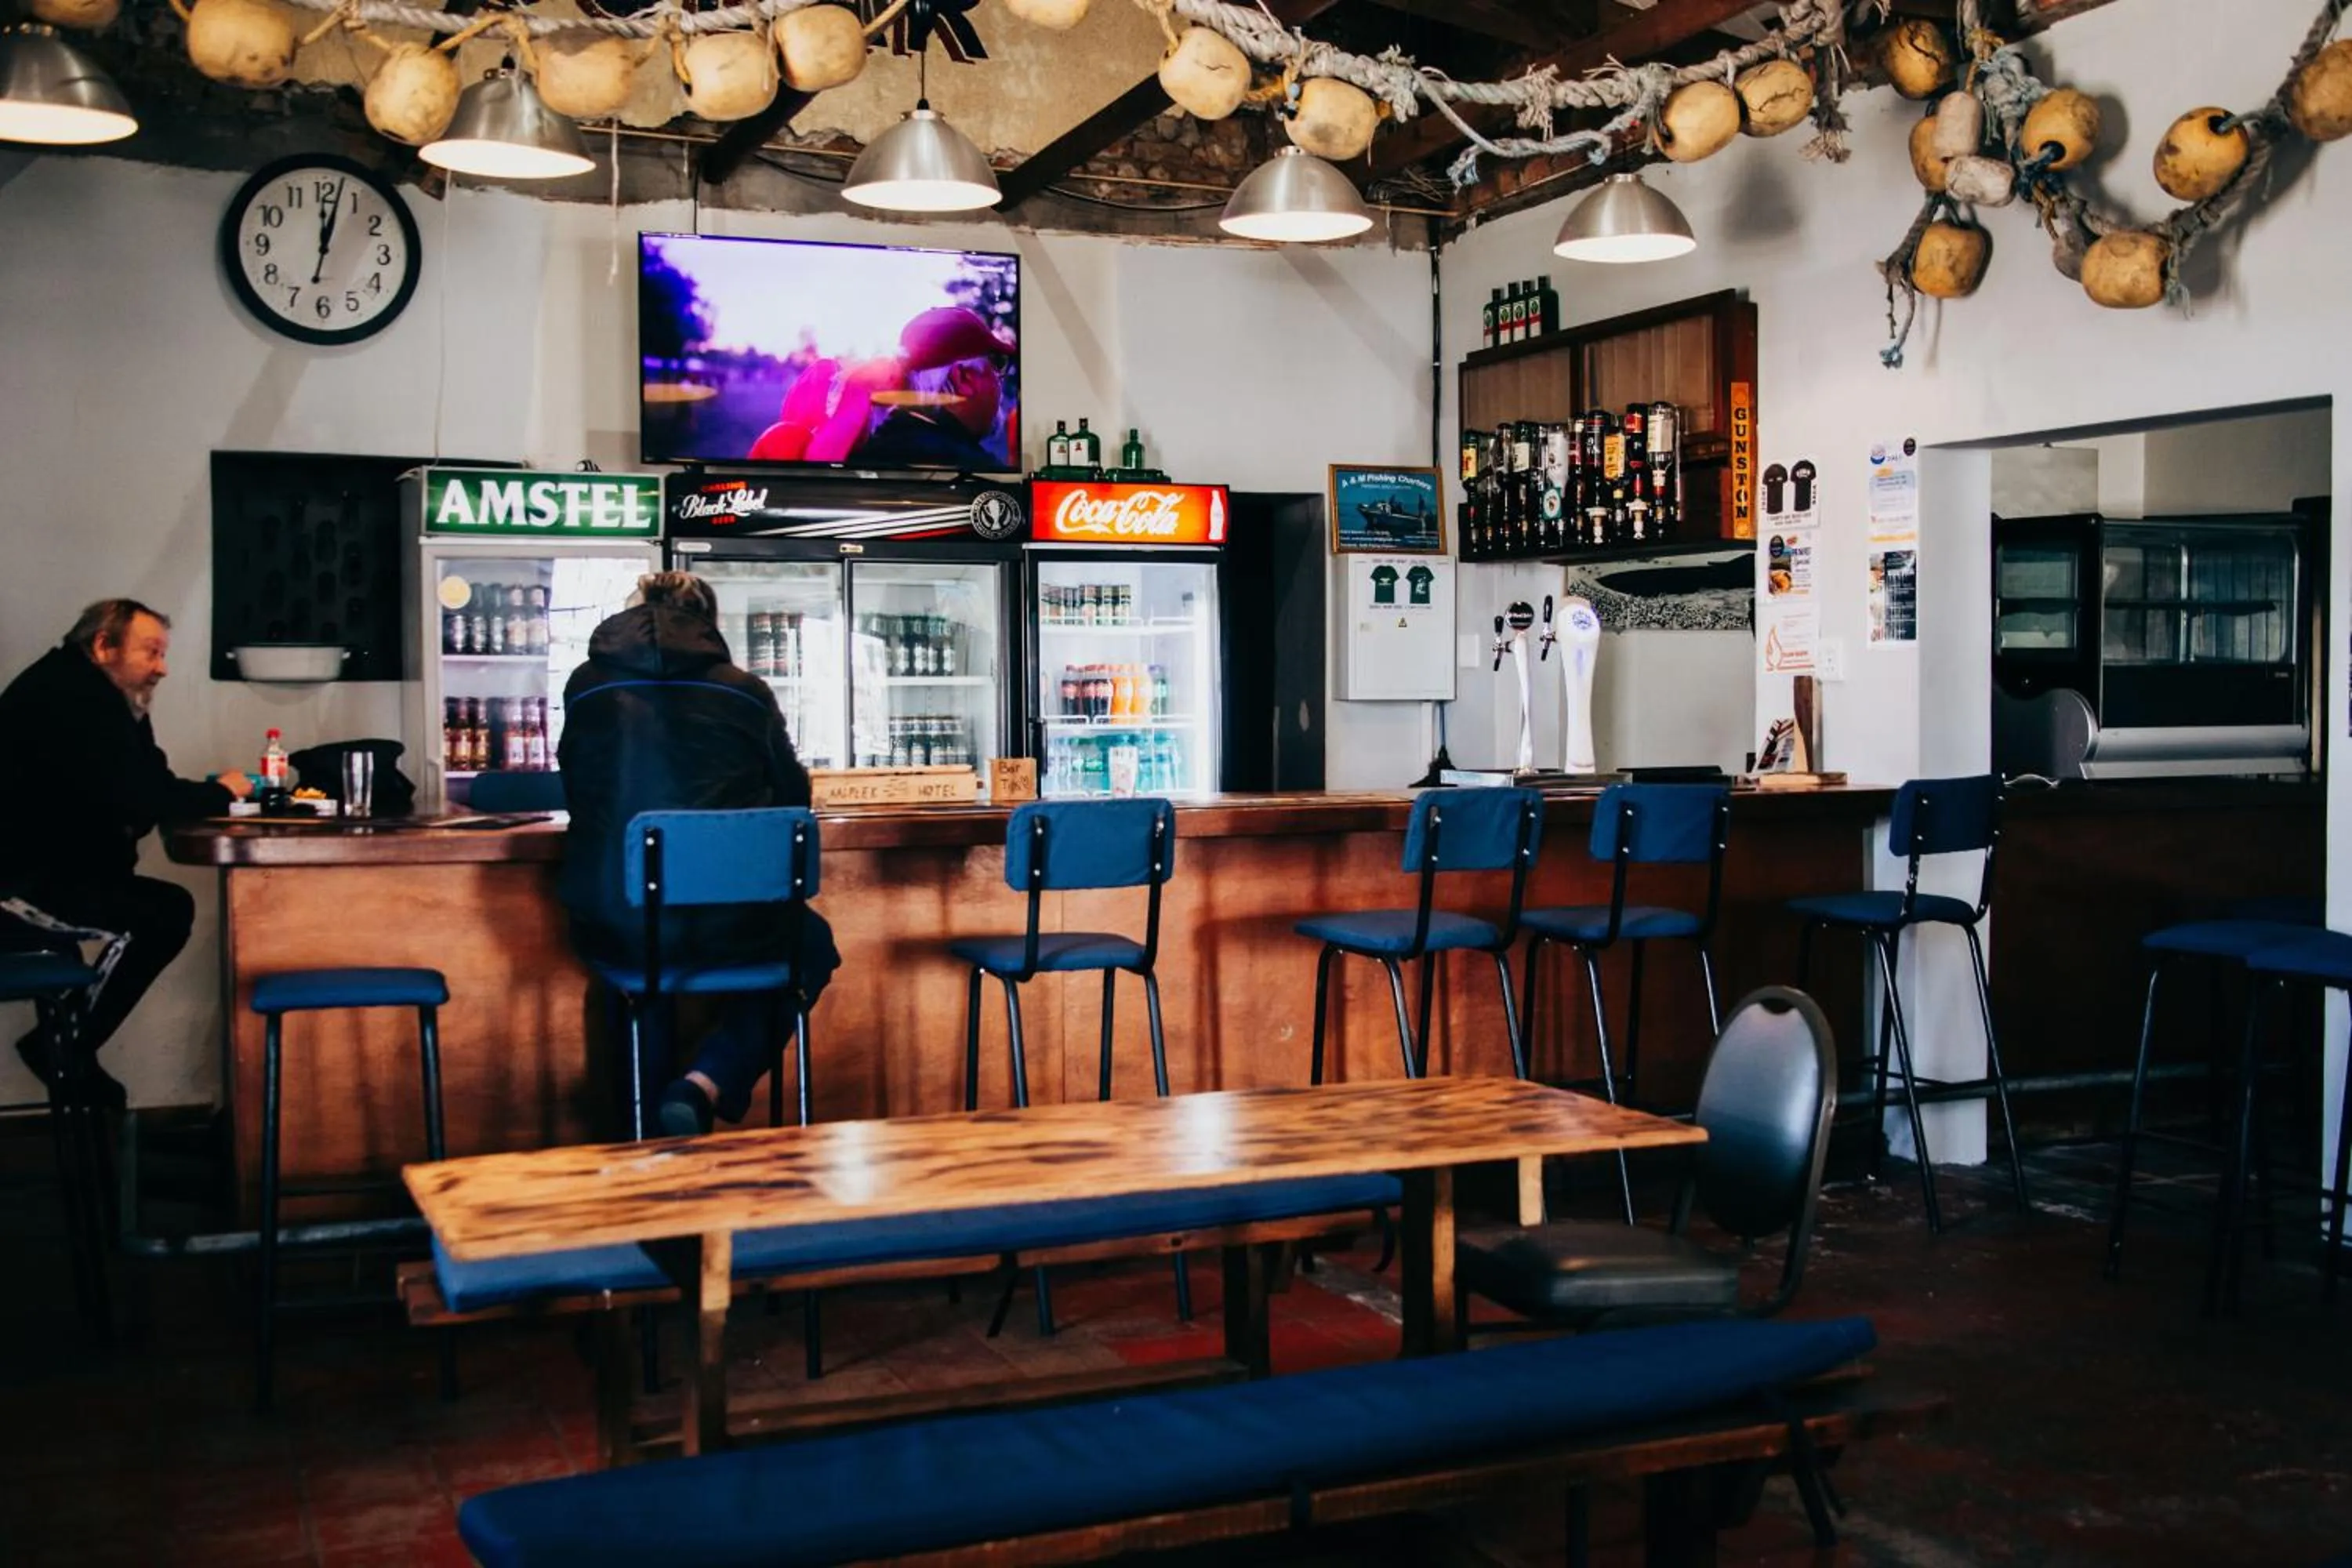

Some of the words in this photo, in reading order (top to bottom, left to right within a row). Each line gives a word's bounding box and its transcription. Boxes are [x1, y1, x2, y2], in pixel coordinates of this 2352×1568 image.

[286, 186, 303, 209] 11
[314, 181, 335, 204] 12
[351, 192, 358, 214] 1
[260, 205, 284, 228] 10
[368, 216, 382, 236] 2
[255, 233, 270, 256] 9
[376, 245, 390, 265] 3
[263, 263, 278, 285] 8
[368, 273, 381, 293] 4
[287, 287, 301, 307] 7
[315, 296, 331, 318] 6
[346, 292, 359, 311] 5
[1733, 407, 1748, 519] GUNSTON
[1367, 474, 1396, 483] Fishing
[1398, 474, 1432, 492] Charters
[436, 479, 652, 528] AMSTEL
[680, 494, 727, 519] Black
[725, 488, 768, 516] Label
[918, 785, 956, 797] HOTEL
